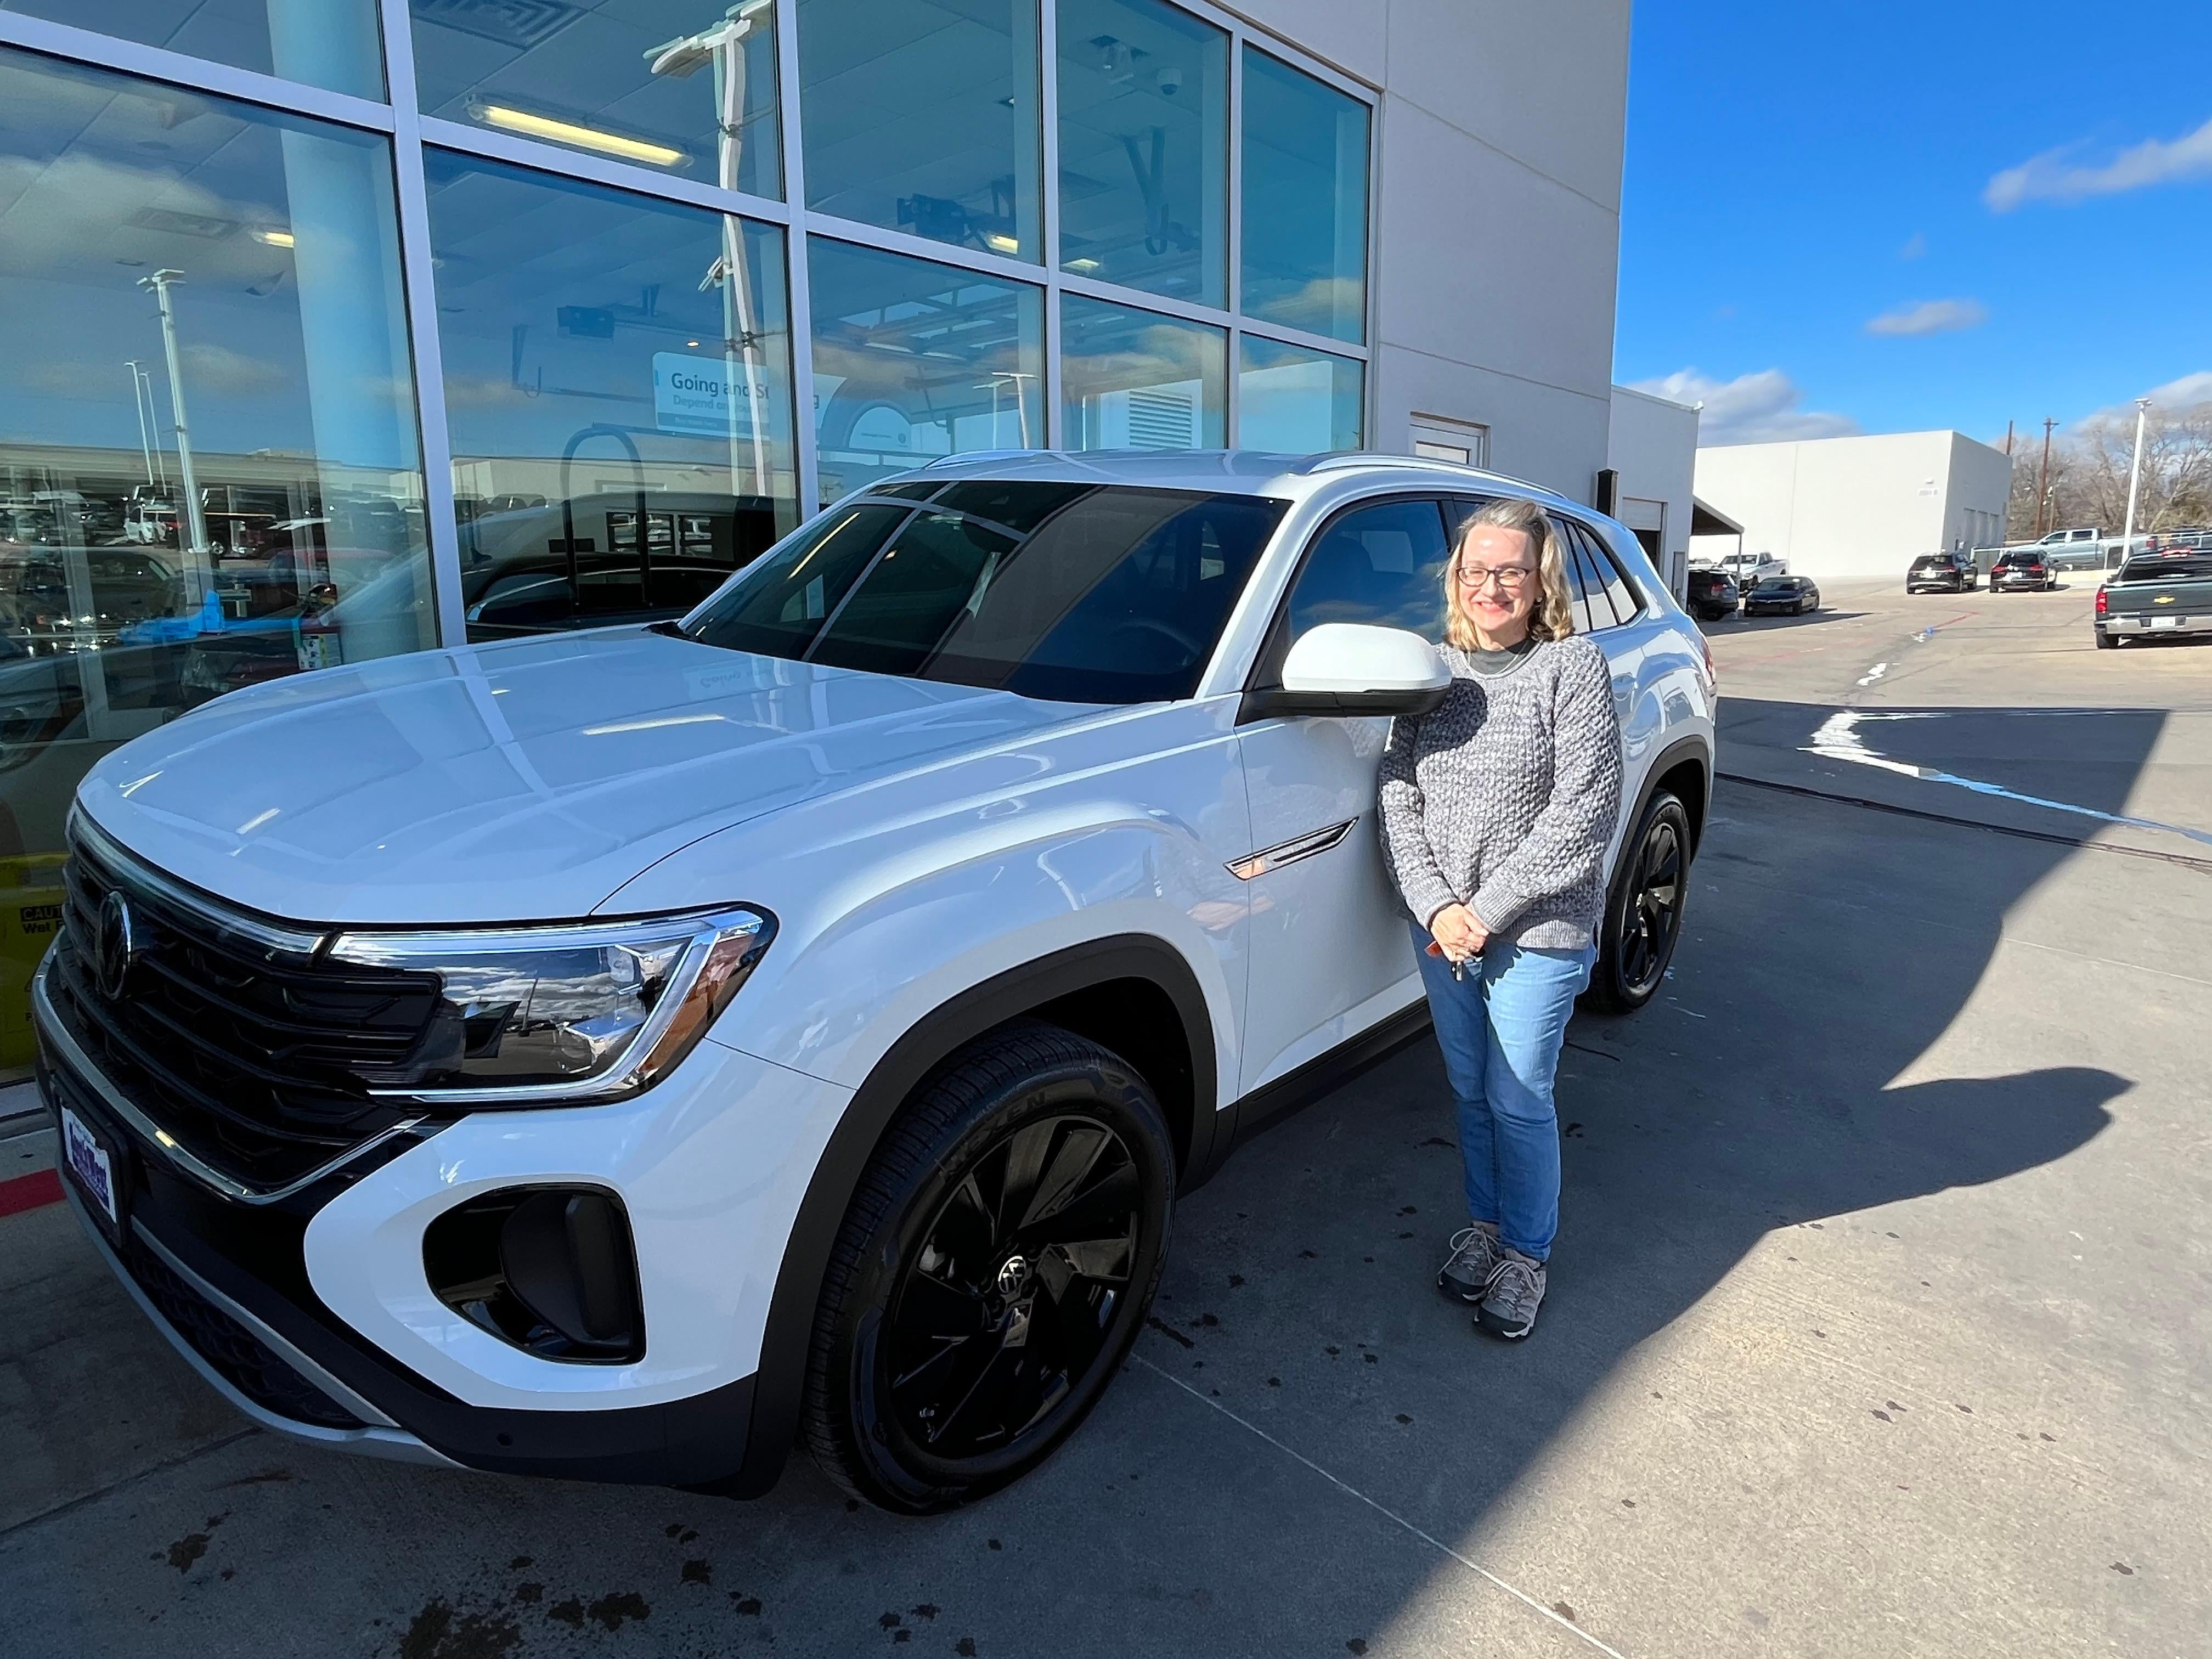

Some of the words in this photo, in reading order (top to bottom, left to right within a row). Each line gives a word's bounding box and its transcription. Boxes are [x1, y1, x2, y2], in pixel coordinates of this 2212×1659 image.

[671, 373, 719, 397] Going
[673, 394, 714, 409] Depend
[22, 905, 63, 920] CAUT
[22, 922, 51, 934] Wet
